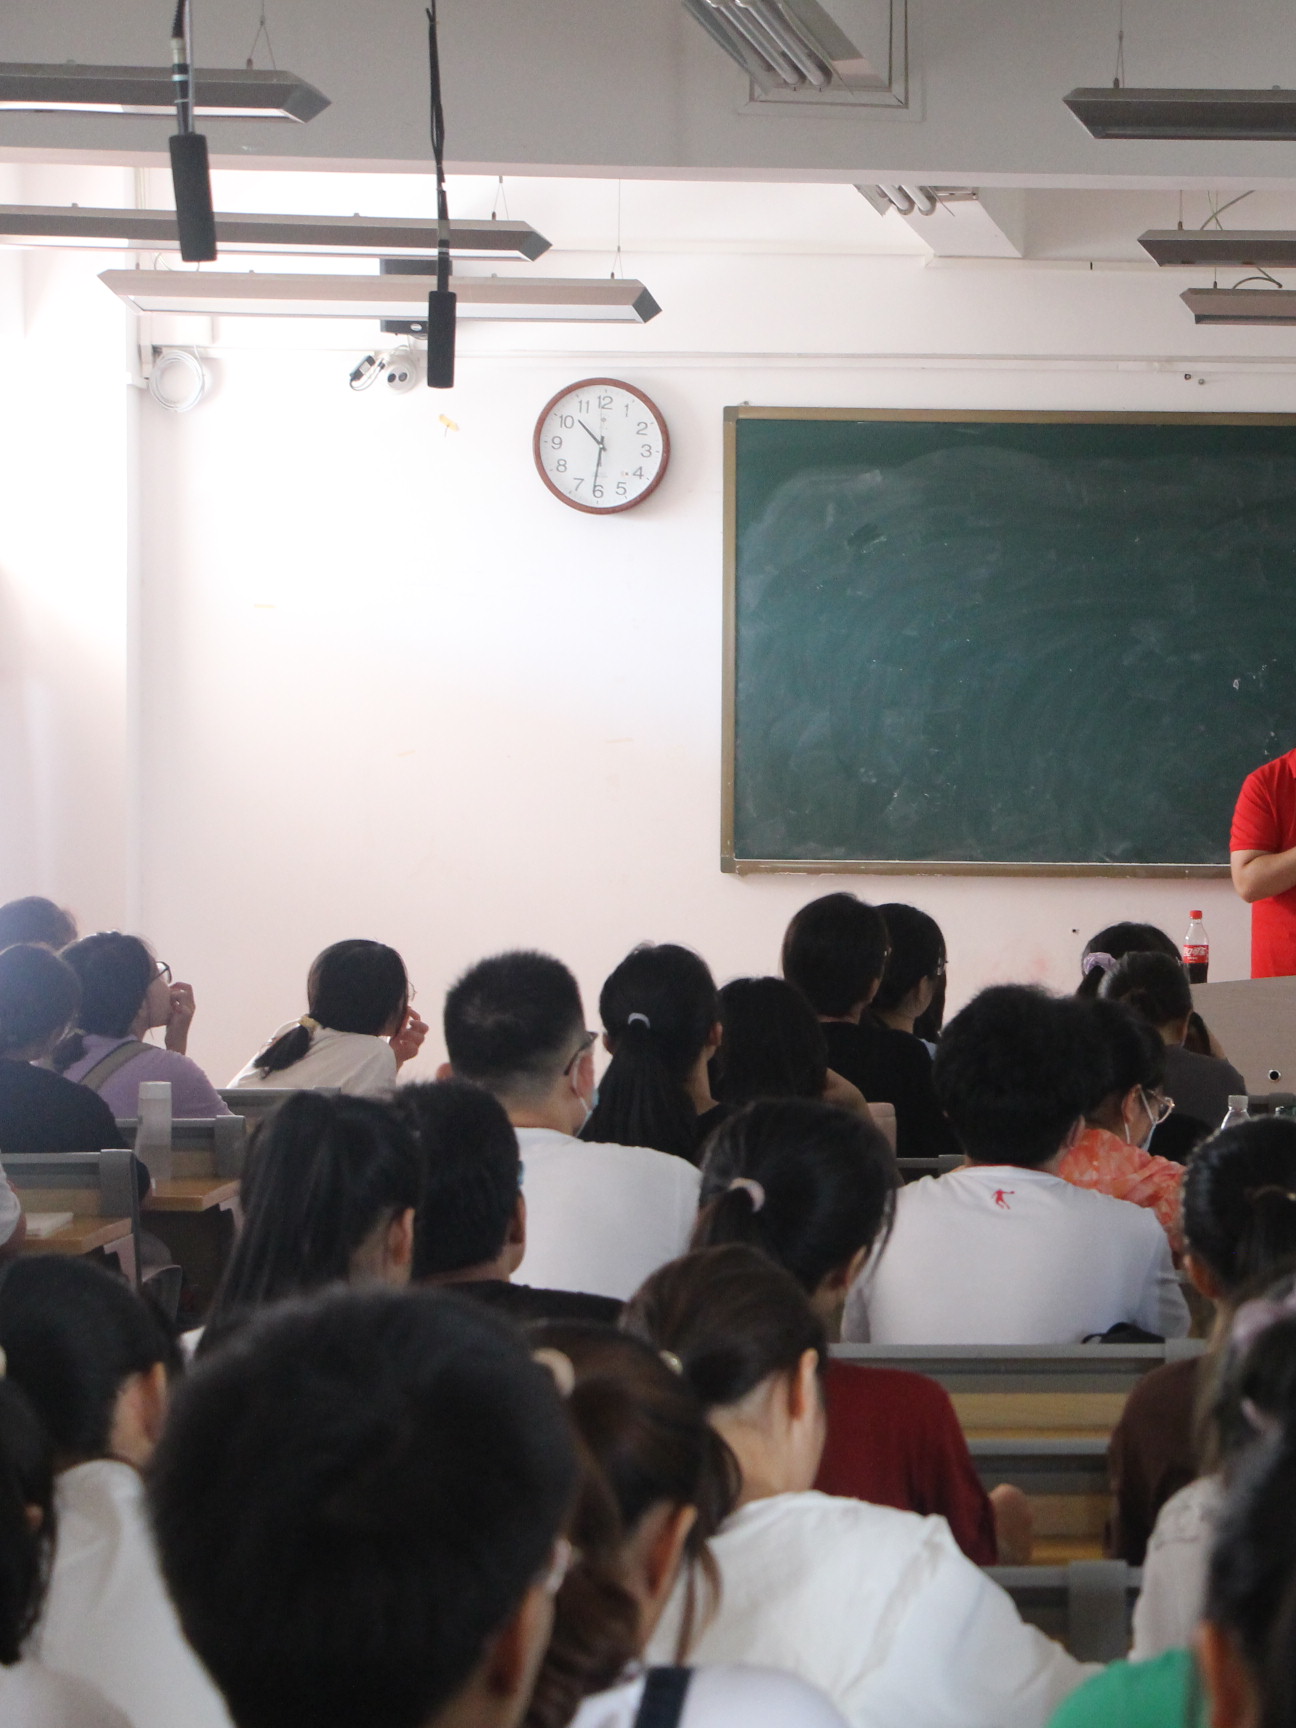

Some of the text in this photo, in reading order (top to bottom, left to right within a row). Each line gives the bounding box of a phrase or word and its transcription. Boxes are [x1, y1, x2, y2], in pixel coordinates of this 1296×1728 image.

[578, 400, 590, 413] 11
[597, 396, 613, 410] 12
[624, 403, 630, 417] 1
[559, 415, 575, 429] 10
[636, 421, 648, 436] 2
[551, 436, 563, 450] 9
[640, 444, 653, 458] 3
[556, 459, 568, 473] 8
[632, 466, 644, 480] 4
[573, 478, 585, 491] 7
[615, 482, 627, 496] 5
[593, 485, 604, 499] 6
